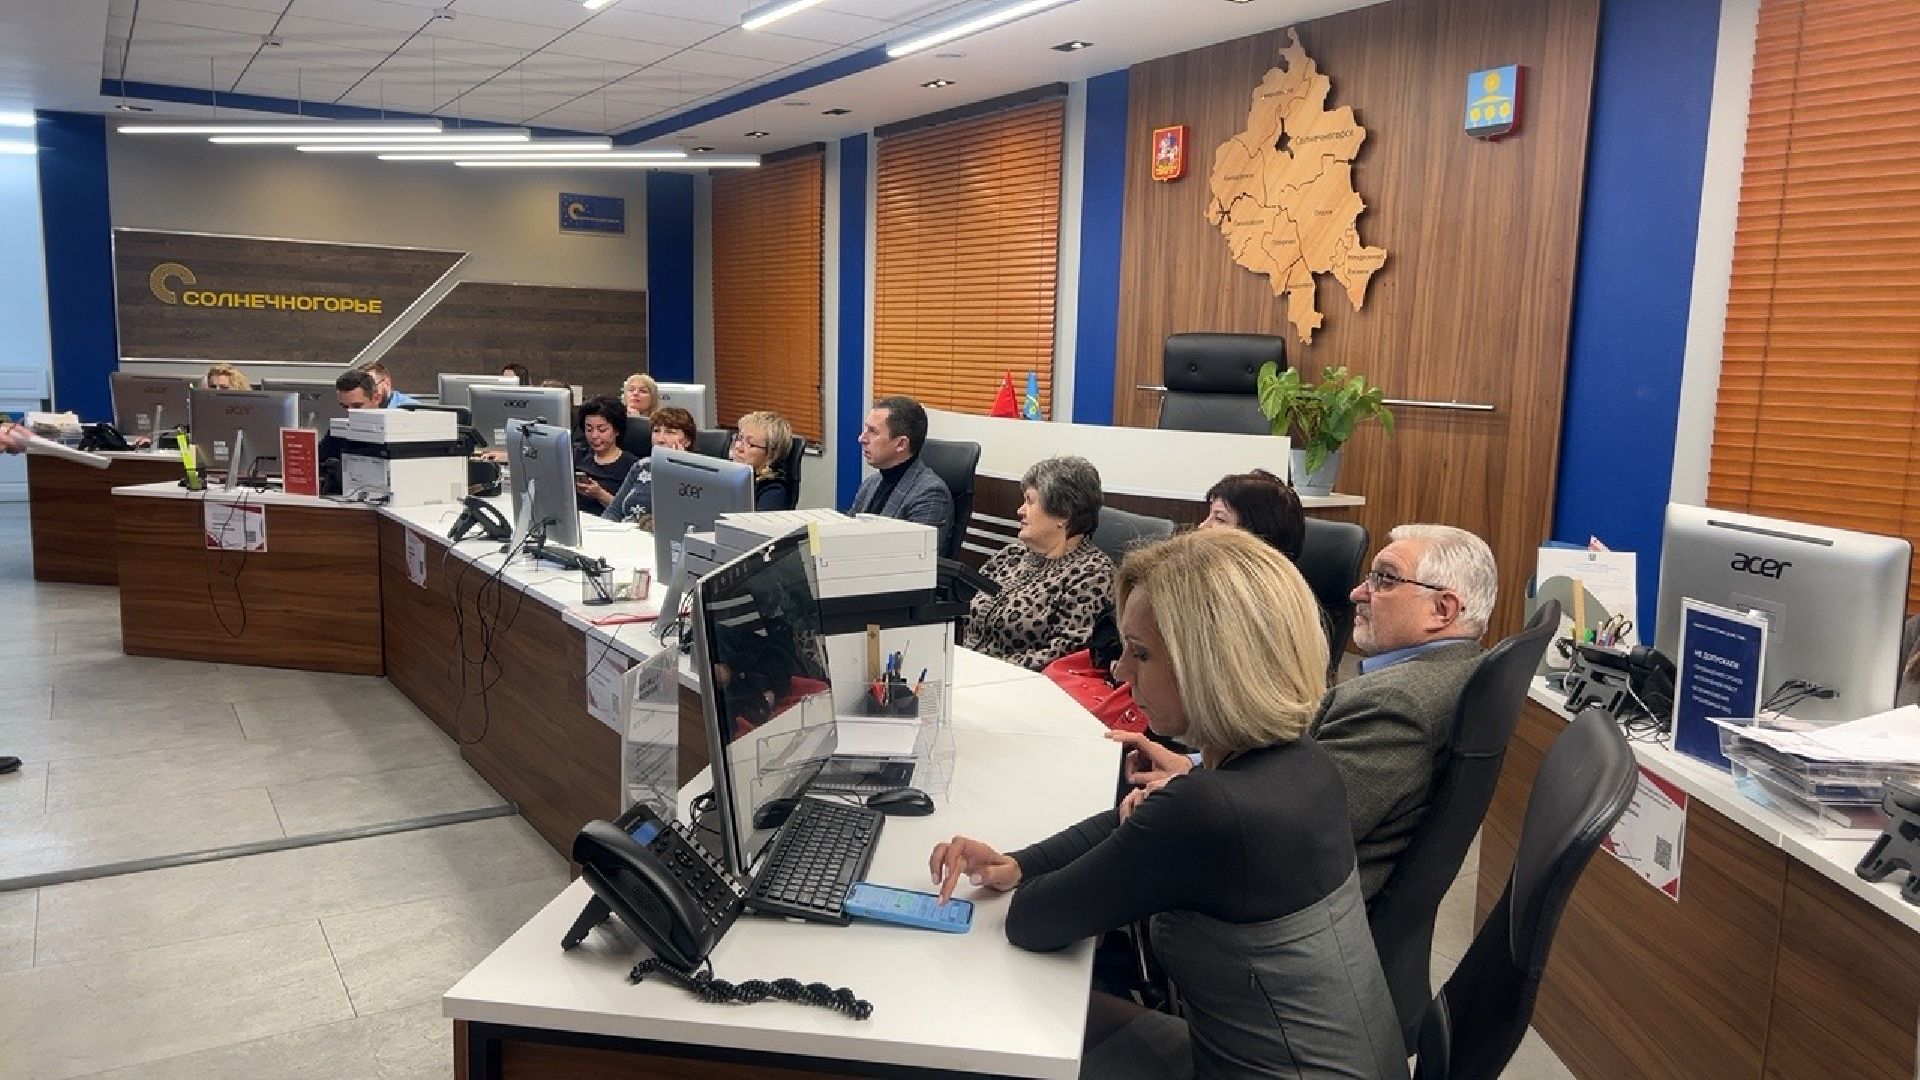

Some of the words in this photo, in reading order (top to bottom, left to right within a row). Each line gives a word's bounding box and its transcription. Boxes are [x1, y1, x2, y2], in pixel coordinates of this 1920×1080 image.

[183, 291, 382, 314] СОЛНЕЧНОГОРЬЕ
[504, 399, 529, 408] acer
[679, 482, 703, 499] acer
[1731, 552, 1792, 579] acer
